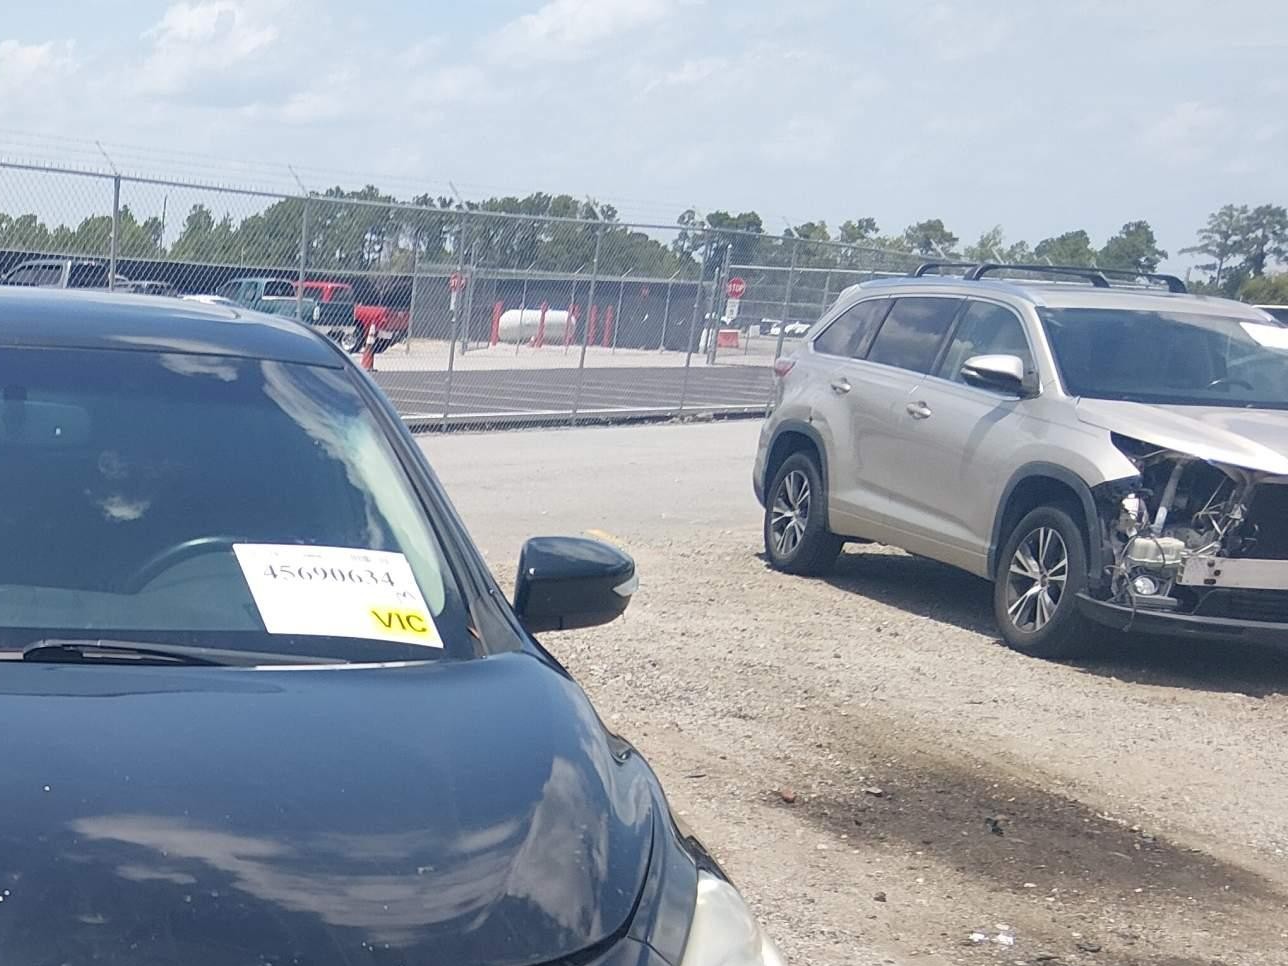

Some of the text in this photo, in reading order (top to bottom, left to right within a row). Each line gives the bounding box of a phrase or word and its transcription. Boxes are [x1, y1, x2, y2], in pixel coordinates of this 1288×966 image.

[728, 283, 744, 292] STOP
[265, 564, 395, 587] 45690634
[371, 610, 428, 634] VIC
